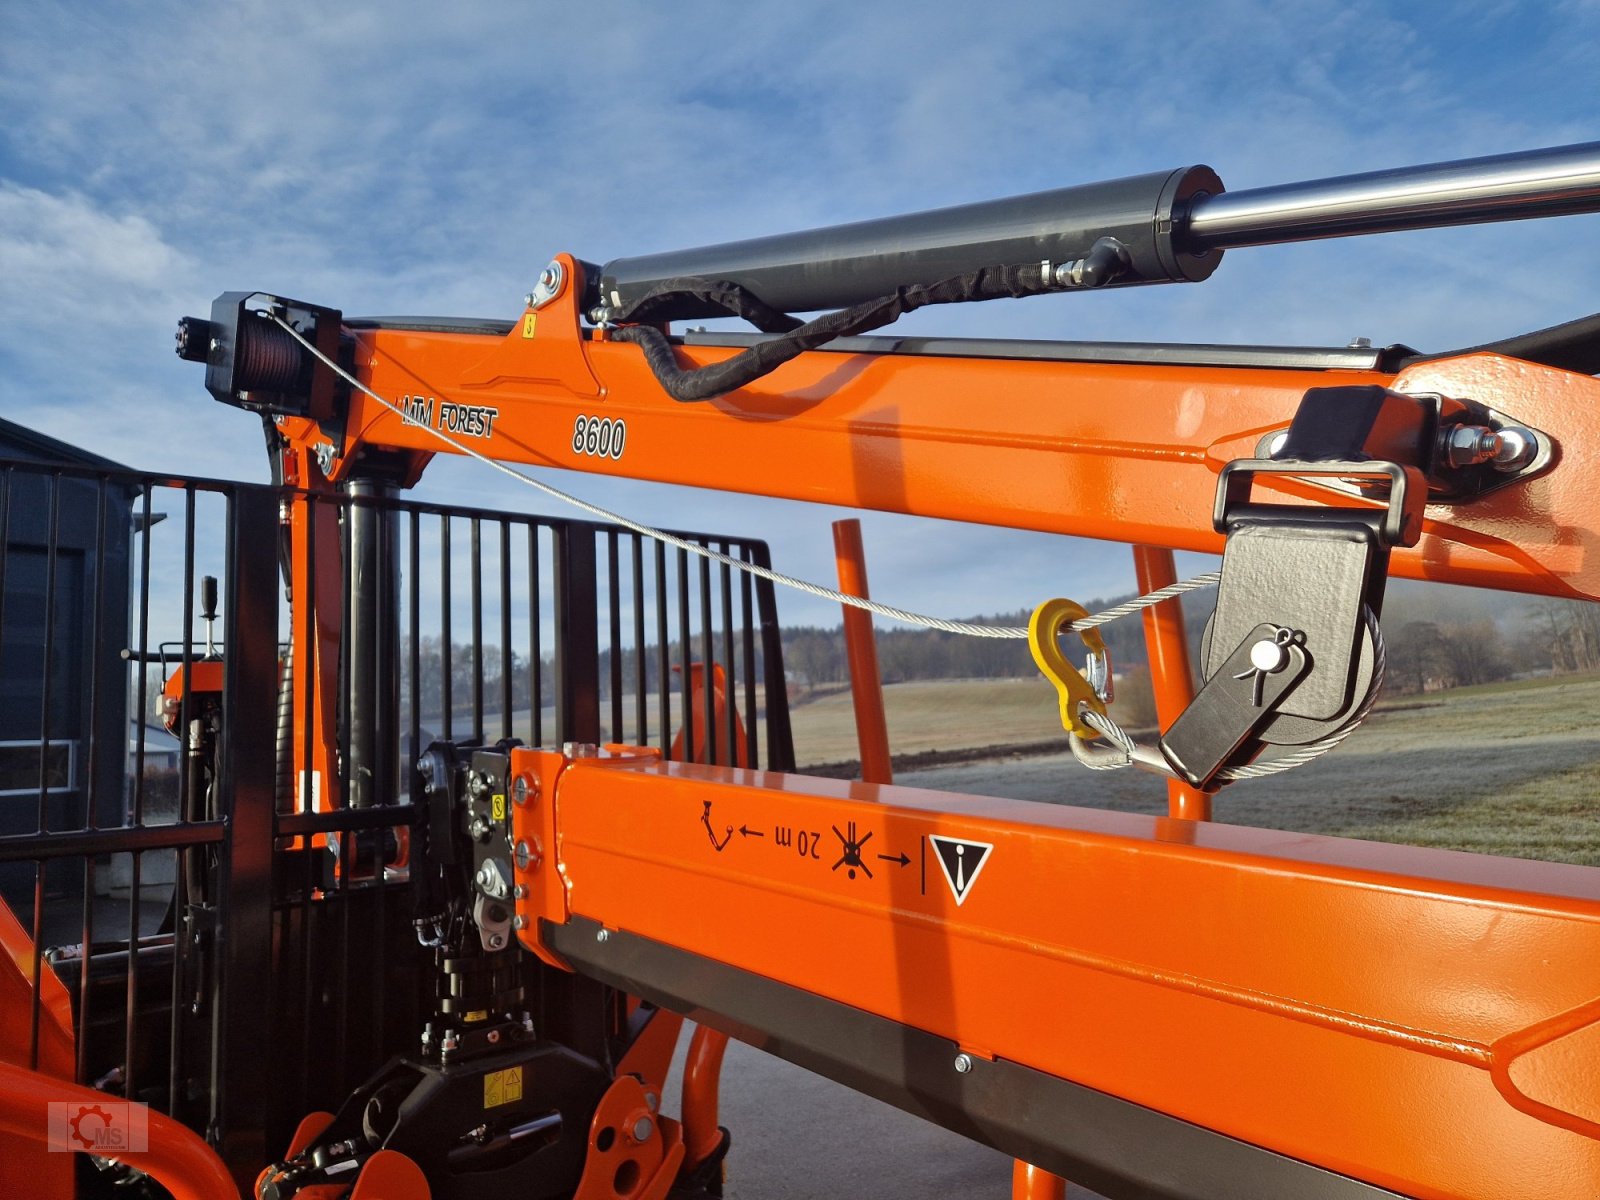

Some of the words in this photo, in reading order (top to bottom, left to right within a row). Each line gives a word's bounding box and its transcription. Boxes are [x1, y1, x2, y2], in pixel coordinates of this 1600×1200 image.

[439, 402, 498, 438] FOREST
[573, 415, 626, 460] 8600
[775, 826, 792, 848] m
[799, 830, 821, 860] 20
